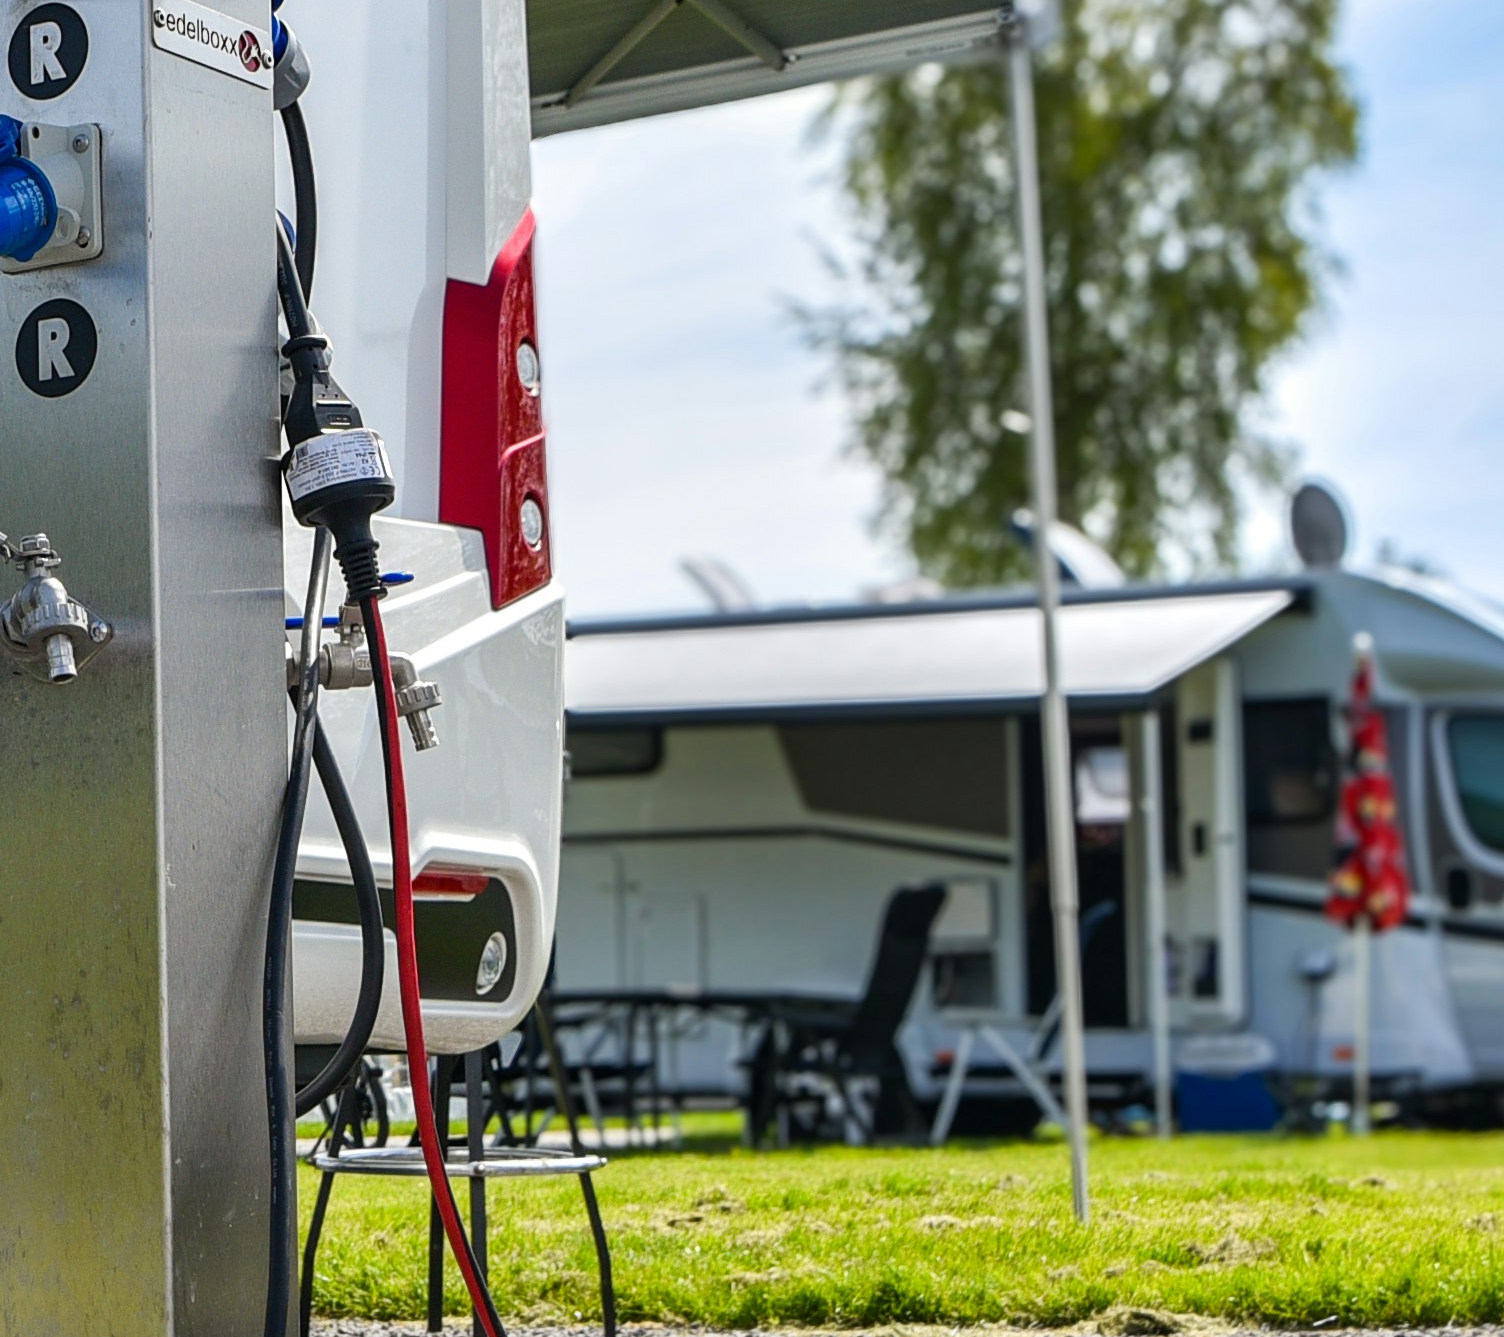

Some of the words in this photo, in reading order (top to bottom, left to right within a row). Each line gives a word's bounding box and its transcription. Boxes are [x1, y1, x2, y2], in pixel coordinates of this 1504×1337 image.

[30, 21, 67, 85] R
[166, 13, 238, 56] edelboxx
[38, 317, 75, 381] R
